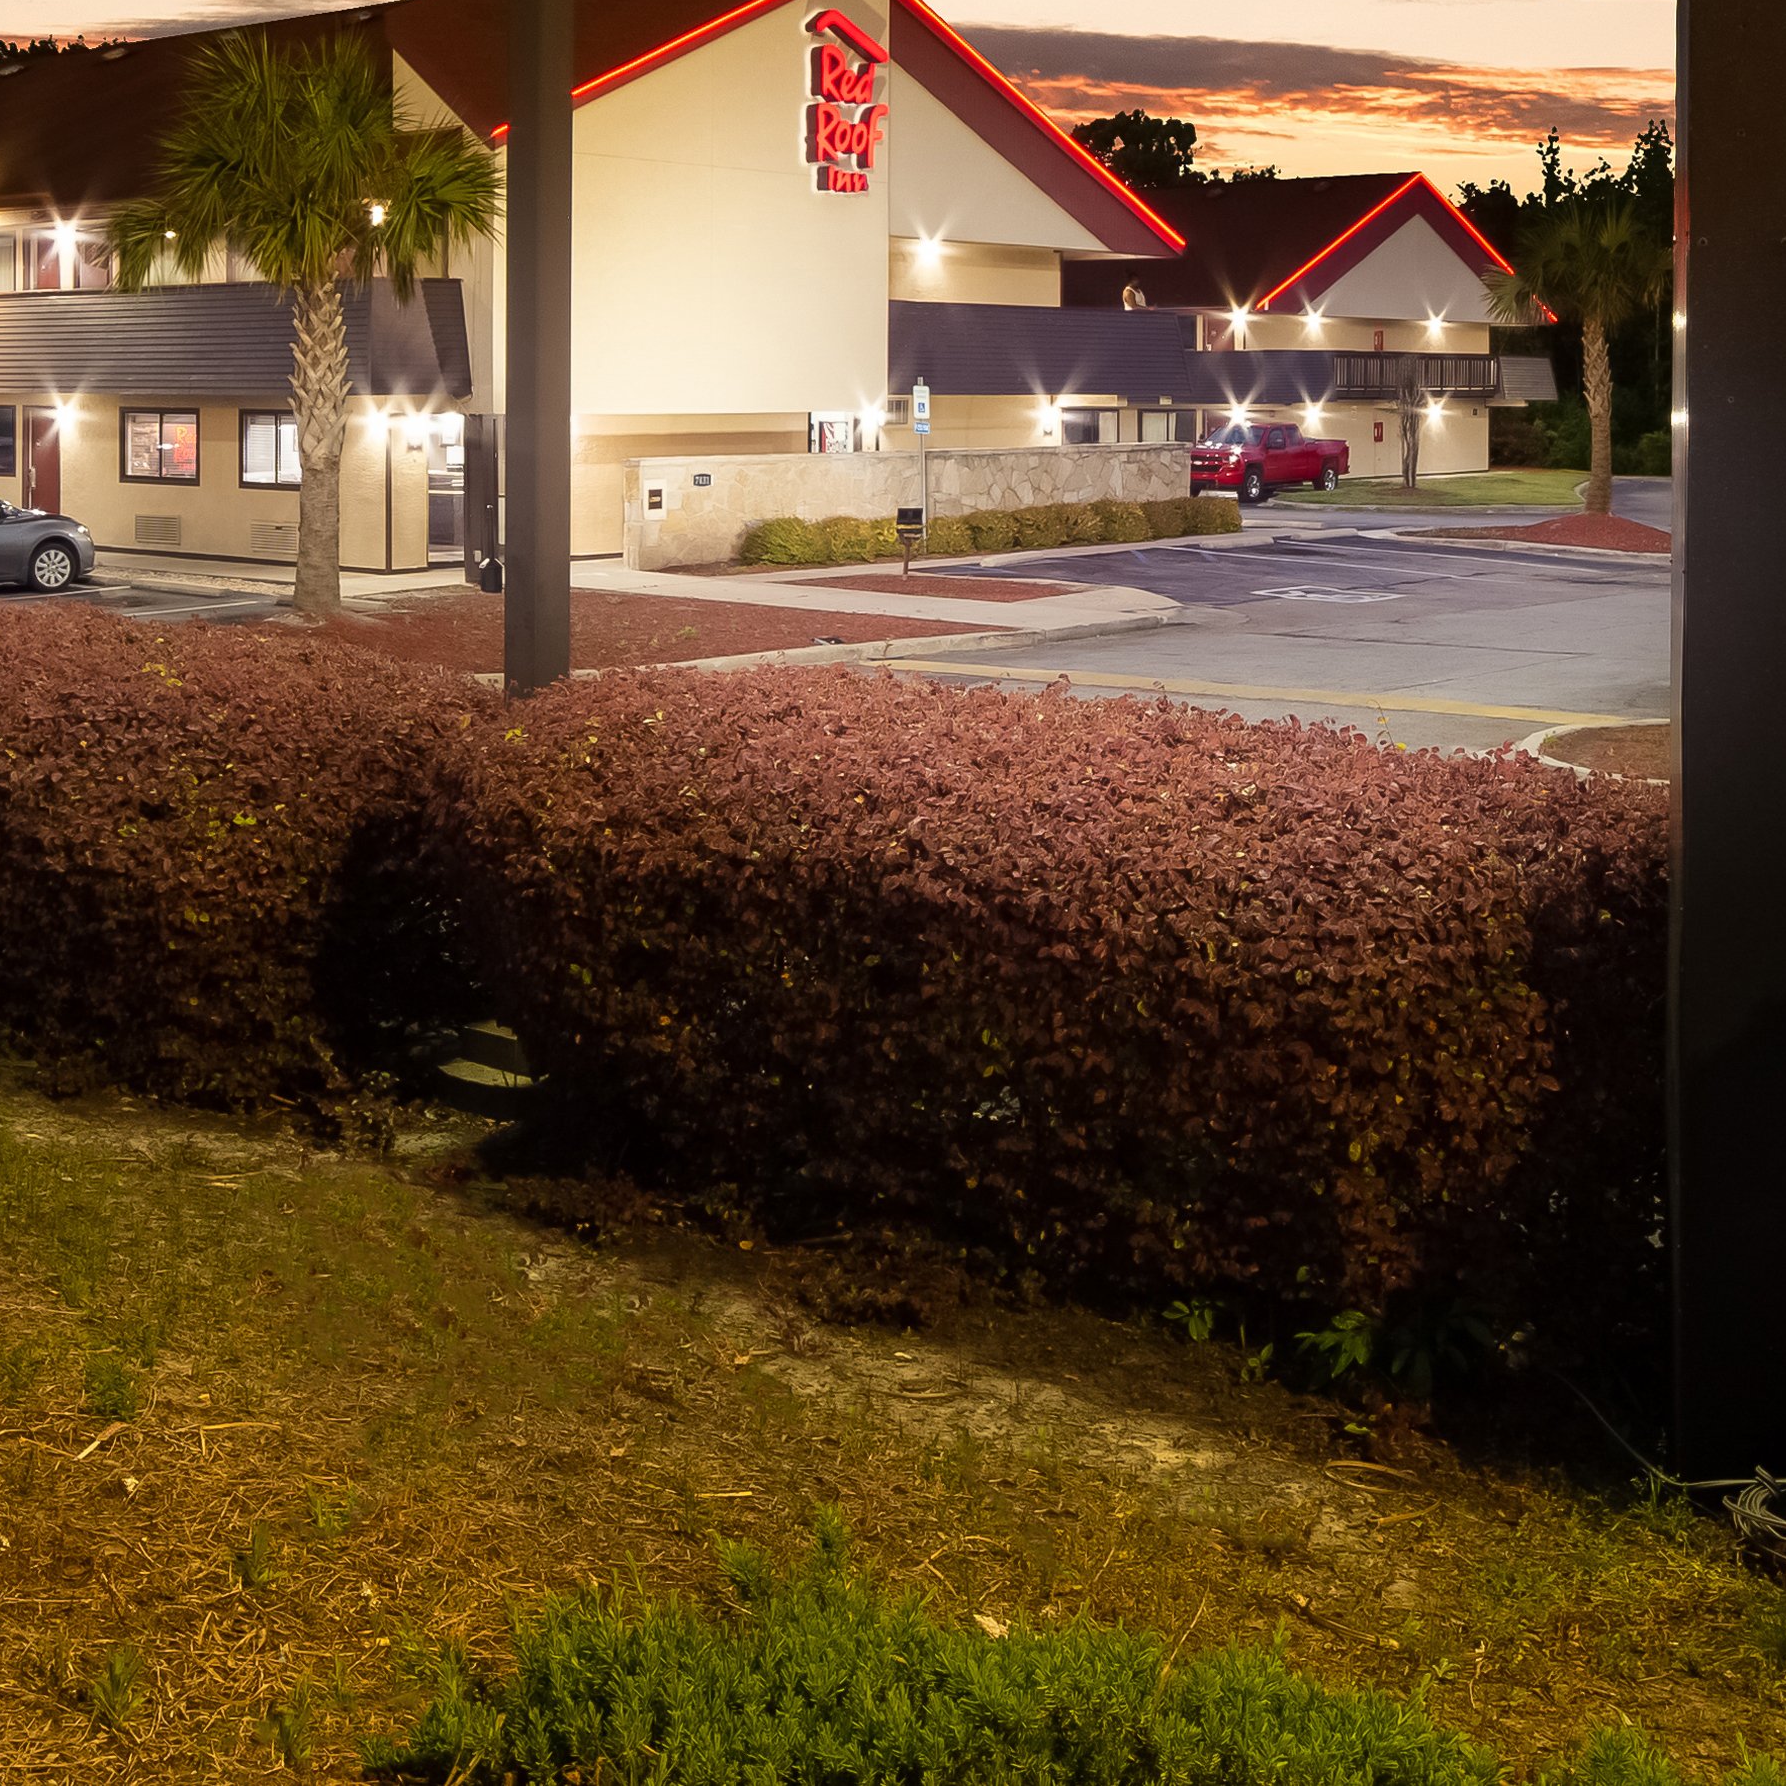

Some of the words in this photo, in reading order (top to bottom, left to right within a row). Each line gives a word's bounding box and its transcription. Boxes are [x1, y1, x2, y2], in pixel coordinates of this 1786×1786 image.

[817, 43, 876, 103] Red
[814, 102, 889, 169] Roof
[824, 165, 870, 192] Inn
